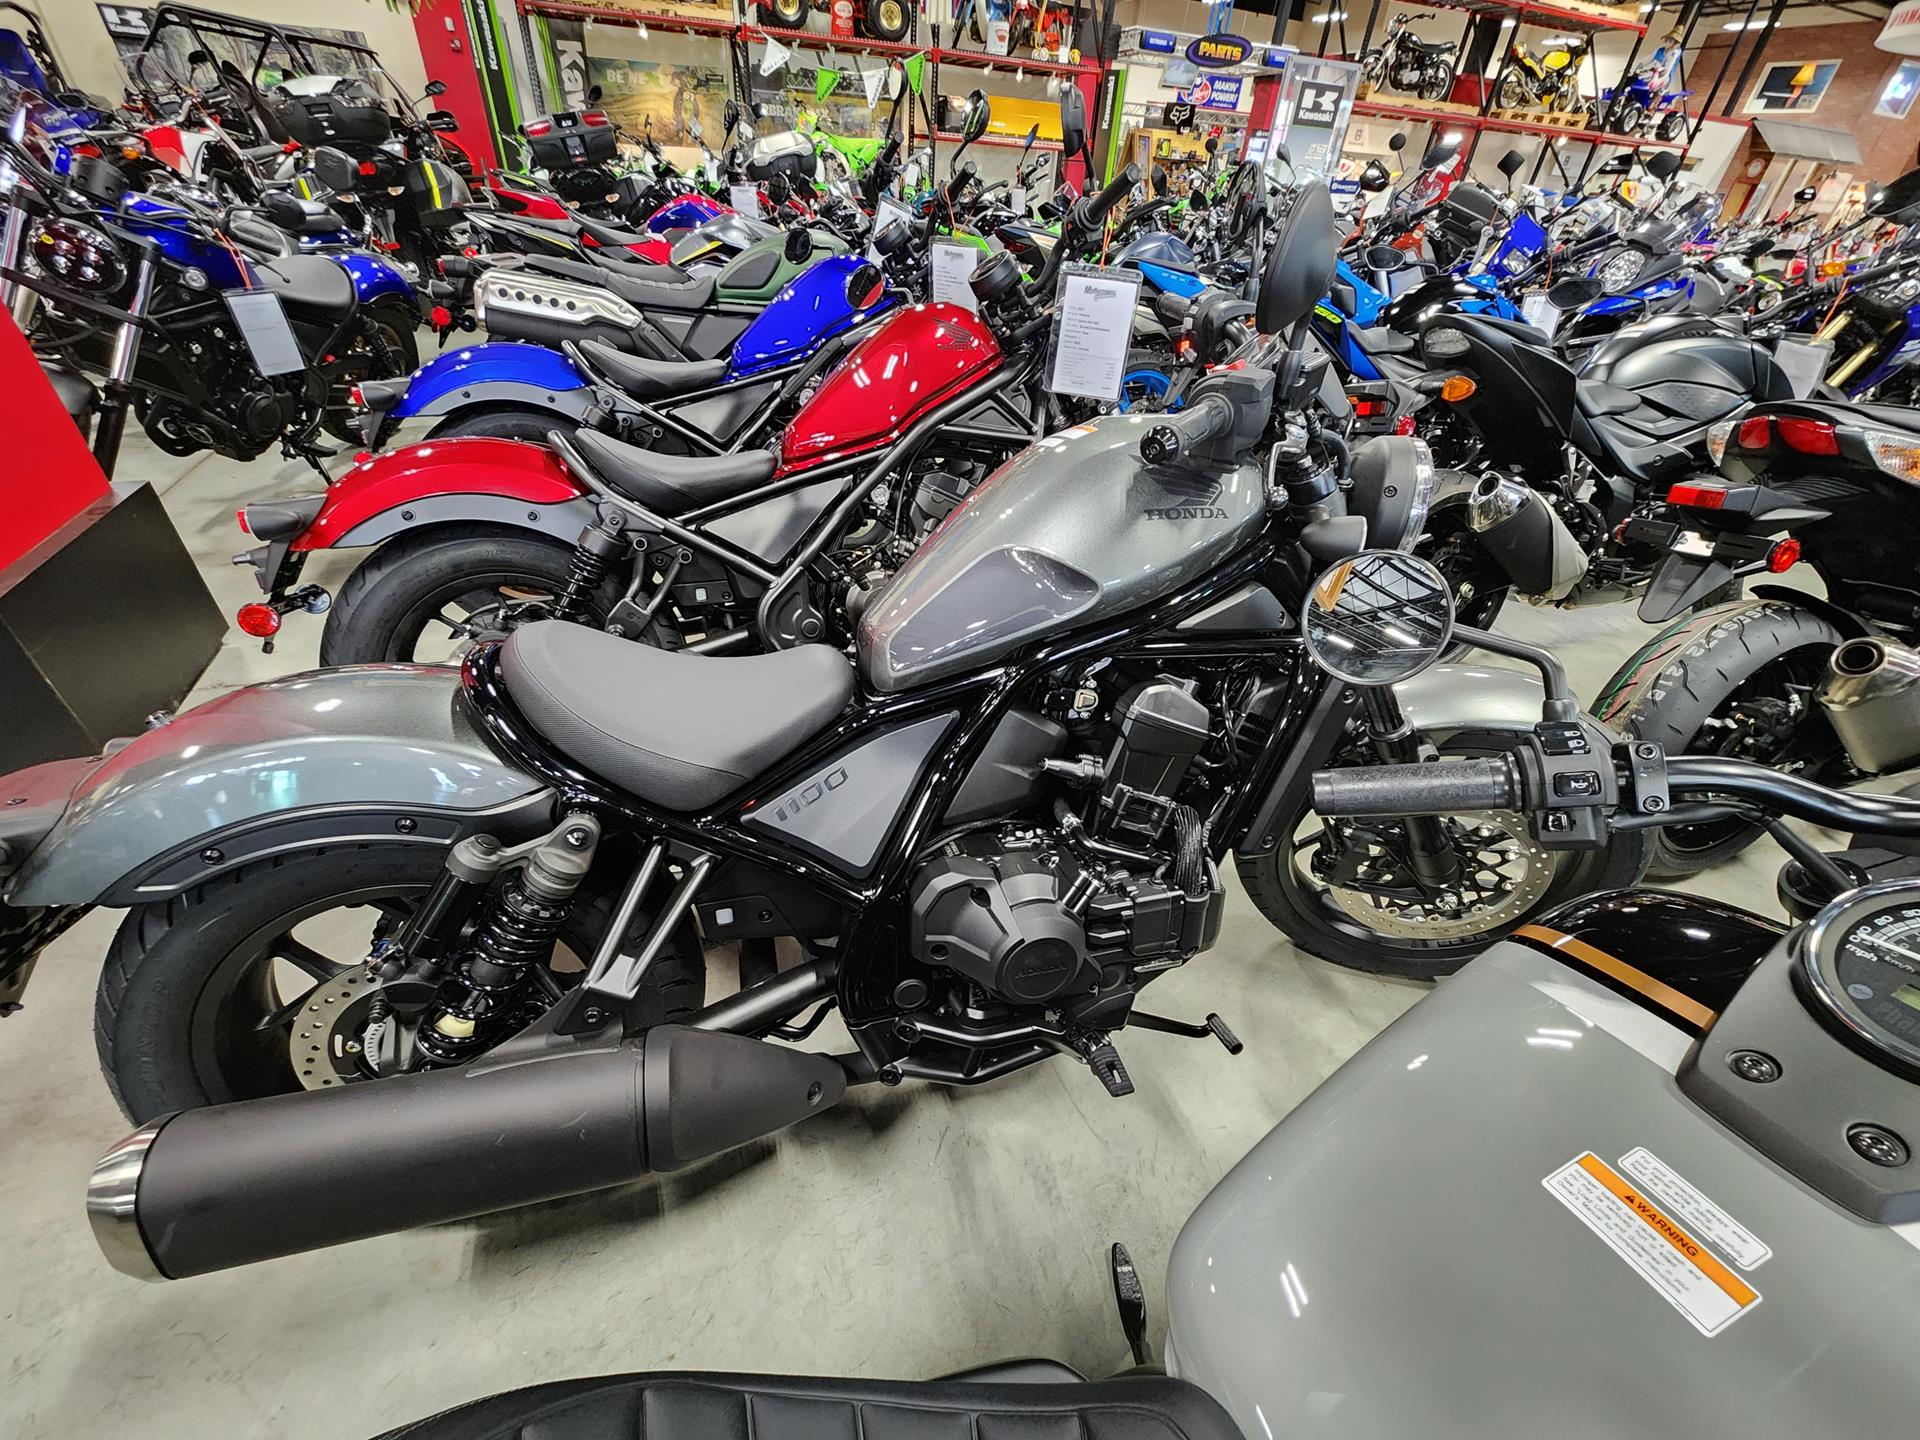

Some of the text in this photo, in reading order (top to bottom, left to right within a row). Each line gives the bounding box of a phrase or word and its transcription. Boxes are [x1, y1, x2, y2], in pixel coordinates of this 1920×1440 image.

[1200, 41, 1243, 61] PARTS
[1213, 80, 1240, 93] MAKIN'
[1102, 75, 1116, 130] Kawasaki
[1210, 91, 1239, 103] POWER!
[1298, 108, 1335, 122] Kawasaki
[1143, 507, 1230, 521] HONDA
[771, 767, 848, 822] 1100
[1845, 943, 1878, 962] mph
[1884, 955, 1916, 974] km/h
[1634, 1202, 1700, 1257] WARNING
